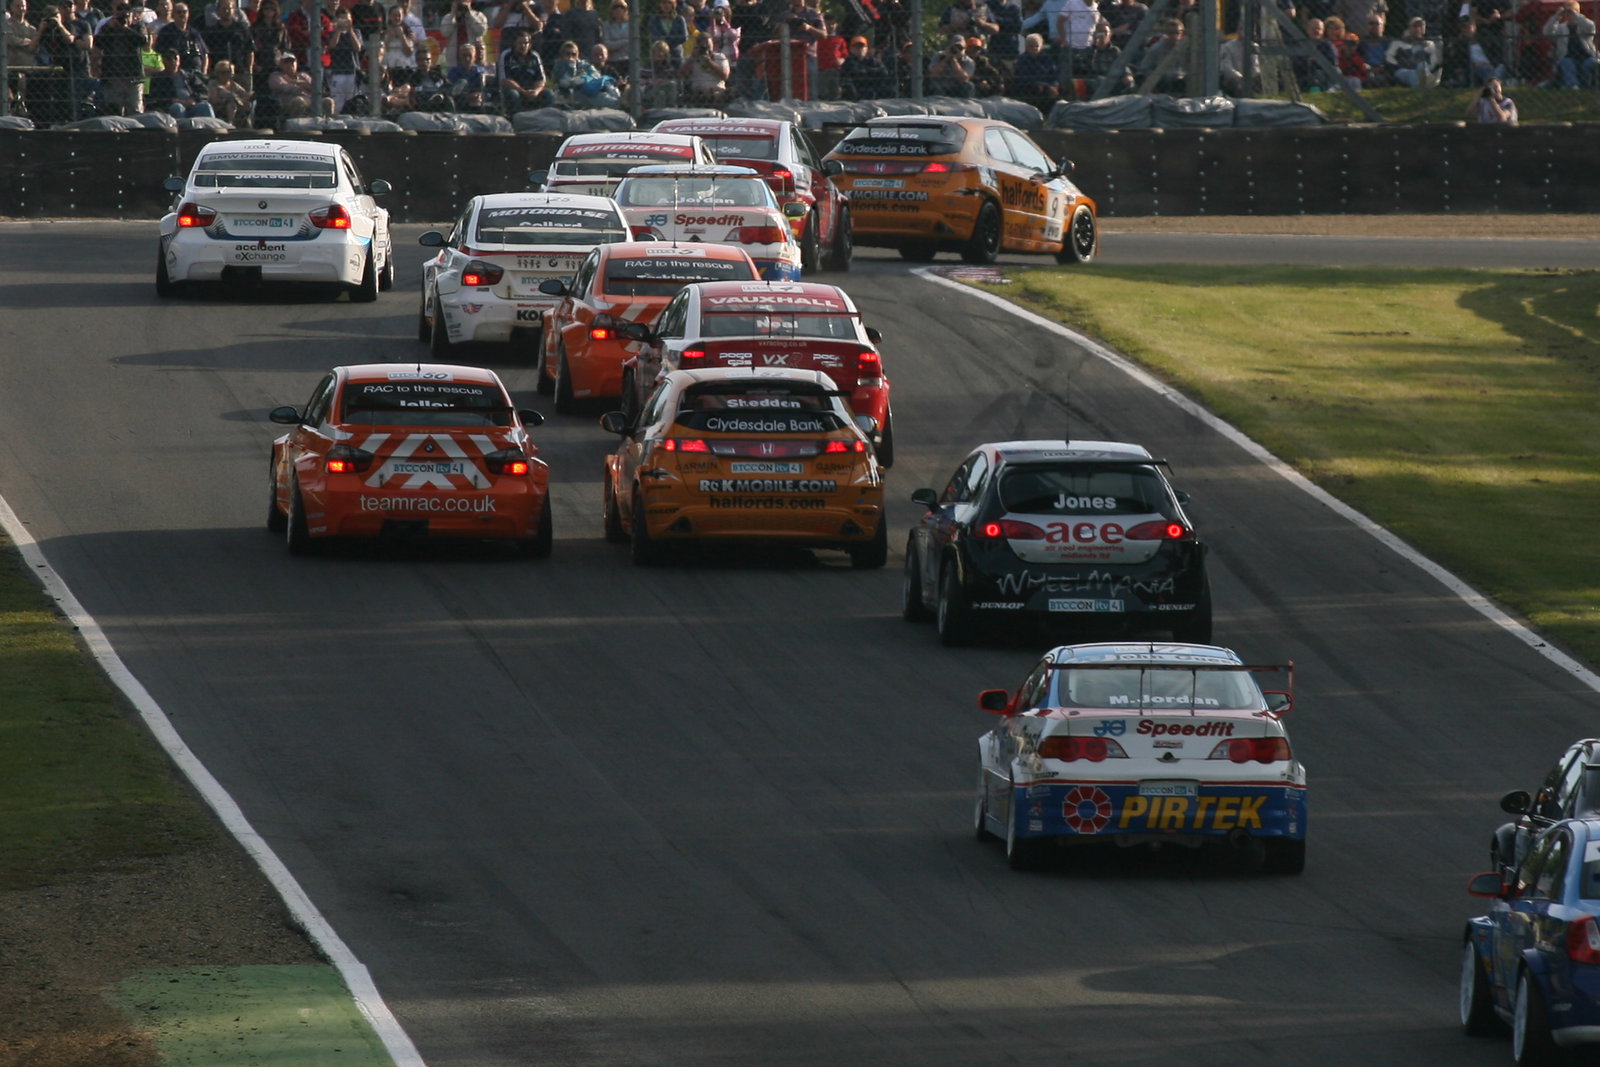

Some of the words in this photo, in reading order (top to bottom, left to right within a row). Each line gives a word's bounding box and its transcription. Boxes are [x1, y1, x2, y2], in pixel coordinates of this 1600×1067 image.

[666, 126, 771, 134] VAUXHALL
[572, 144, 685, 154] MOTORBASE
[843, 144, 897, 154] Clydesdale
[900, 144, 927, 154] Bank
[1002, 179, 1044, 211] halfords
[1052, 196, 1059, 217] 9
[488, 208, 609, 219] MOTORBASE
[674, 214, 745, 227] Speedfit
[625, 260, 652, 268] RAC
[708, 296, 839, 308] VAUXHALL
[363, 385, 393, 393] RAC
[438, 386, 483, 395] rescue
[727, 398, 801, 409] Shedden
[706, 417, 787, 432] Clydesdale
[790, 418, 825, 431] Bank
[360, 494, 496, 513] teamrac.co.uk
[710, 496, 826, 509] halfords.com
[1053, 493, 1117, 510] Jones
[1045, 522, 1124, 544] ace
[980, 602, 1025, 610] DUNLOP
[1109, 694, 1219, 706] M.Jordan
[1136, 718, 1235, 738] Speedfit
[1118, 795, 1267, 830] PIRTEK
